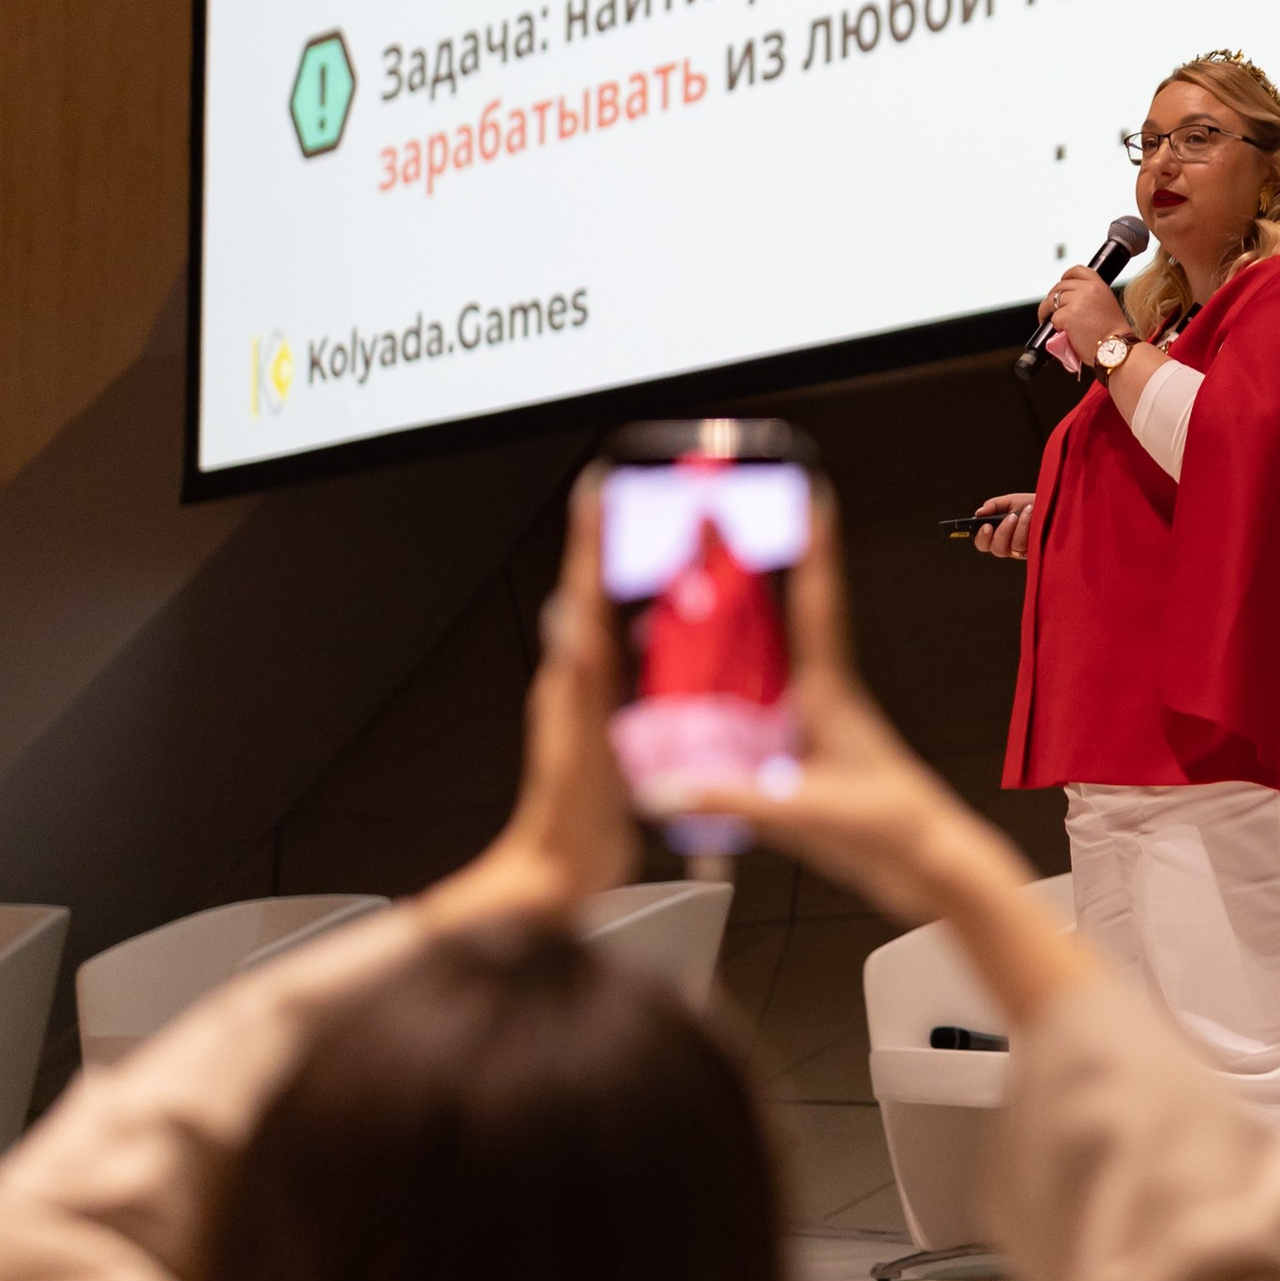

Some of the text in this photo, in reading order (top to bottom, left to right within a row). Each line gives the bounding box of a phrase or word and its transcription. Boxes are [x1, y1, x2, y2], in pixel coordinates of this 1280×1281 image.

[380, 6, 549, 102] Задача:
[380, 60, 707, 195] зарабатывать
[727, 31, 785, 91] из
[307, 286, 589, 385] Kolyada.Games
